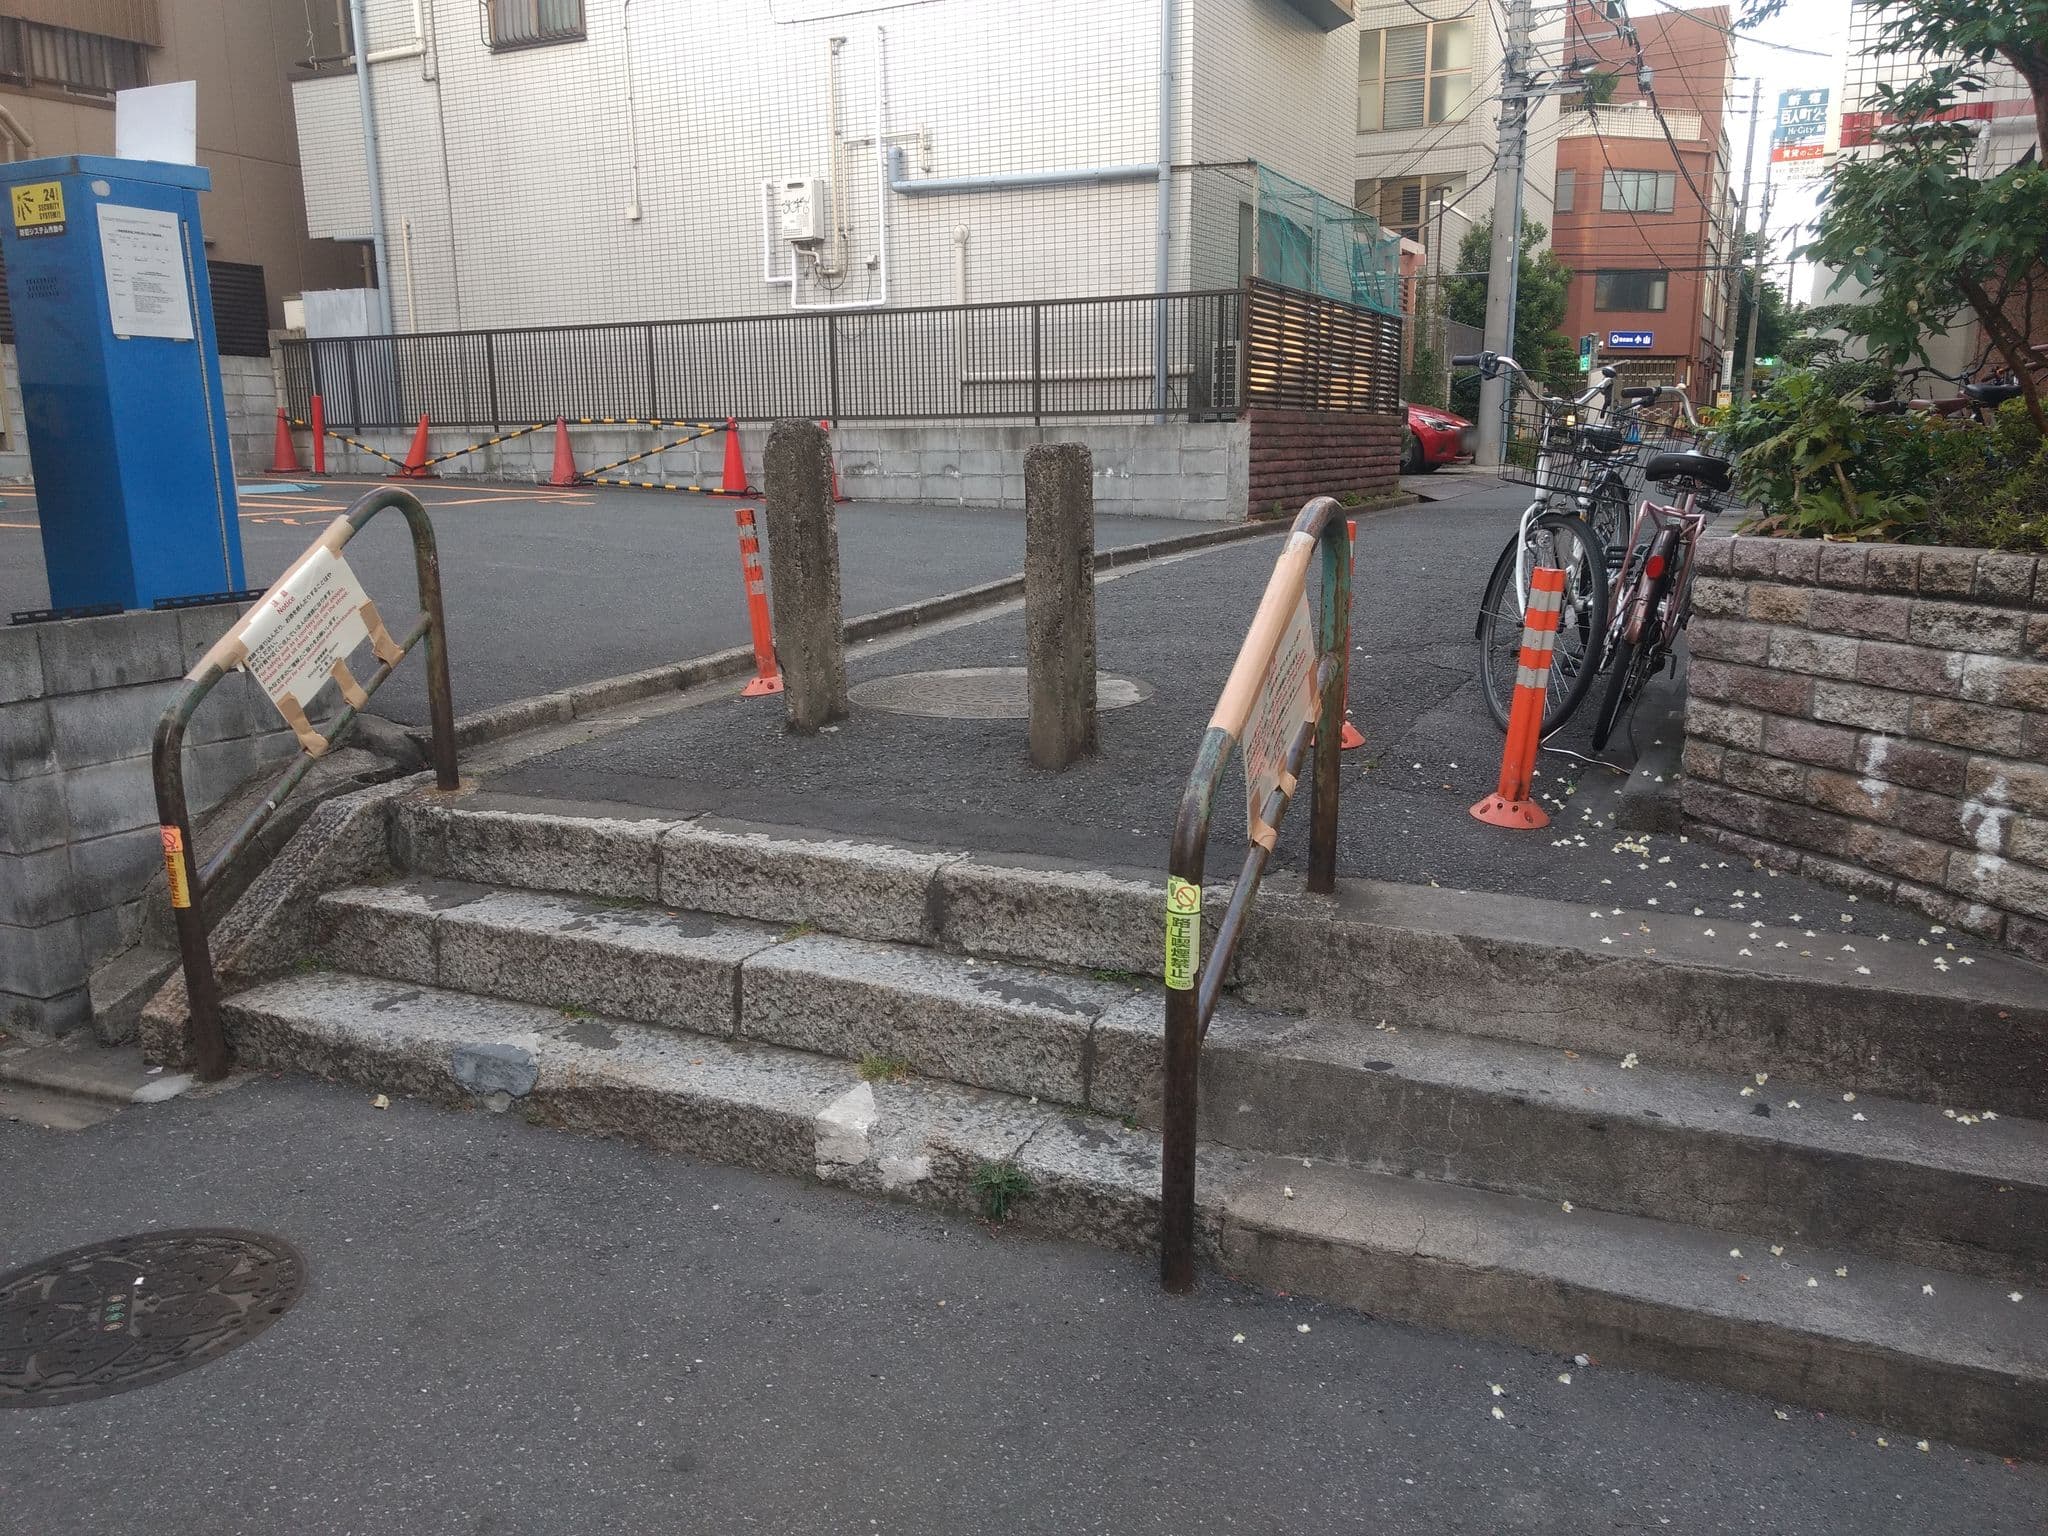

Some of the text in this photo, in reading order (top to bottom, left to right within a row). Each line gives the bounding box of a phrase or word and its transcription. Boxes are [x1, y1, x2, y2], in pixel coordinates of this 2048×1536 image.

[276, 594, 295, 615] Notice
[1170, 916, 1191, 978] 路上喫煙禁止
